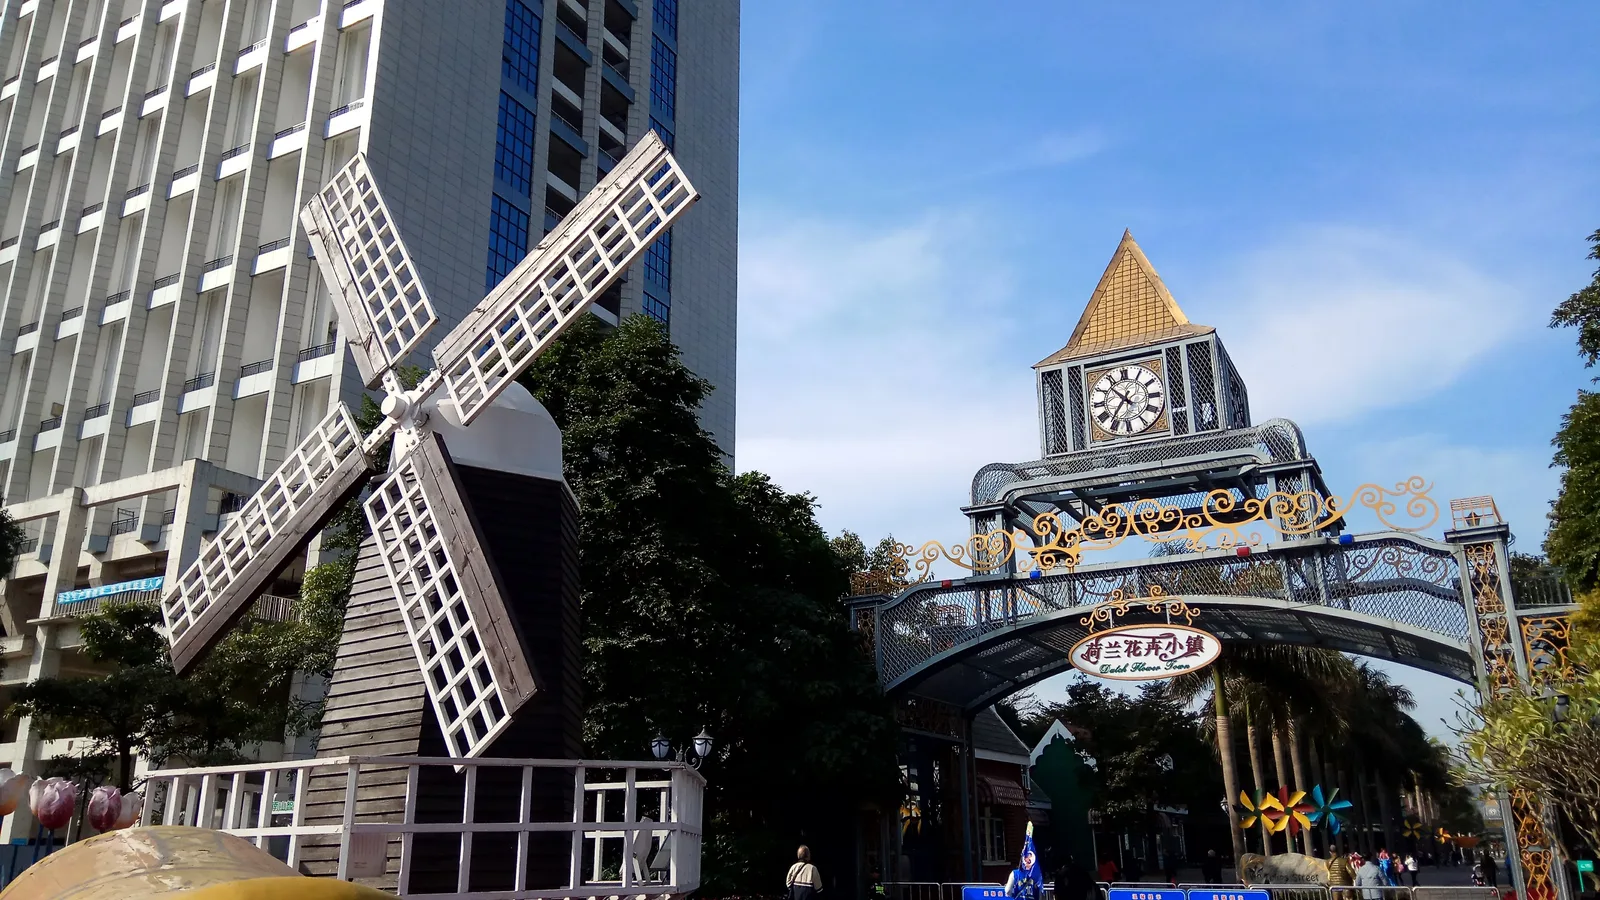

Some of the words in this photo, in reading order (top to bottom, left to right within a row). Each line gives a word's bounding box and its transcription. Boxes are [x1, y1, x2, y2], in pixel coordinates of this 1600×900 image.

[1080, 632, 1205, 664] 荷兰花卉小镇
[1099, 662, 1129, 674] Dutch
[1130, 661, 1161, 673] Flower
[1164, 660, 1191, 671] Town
